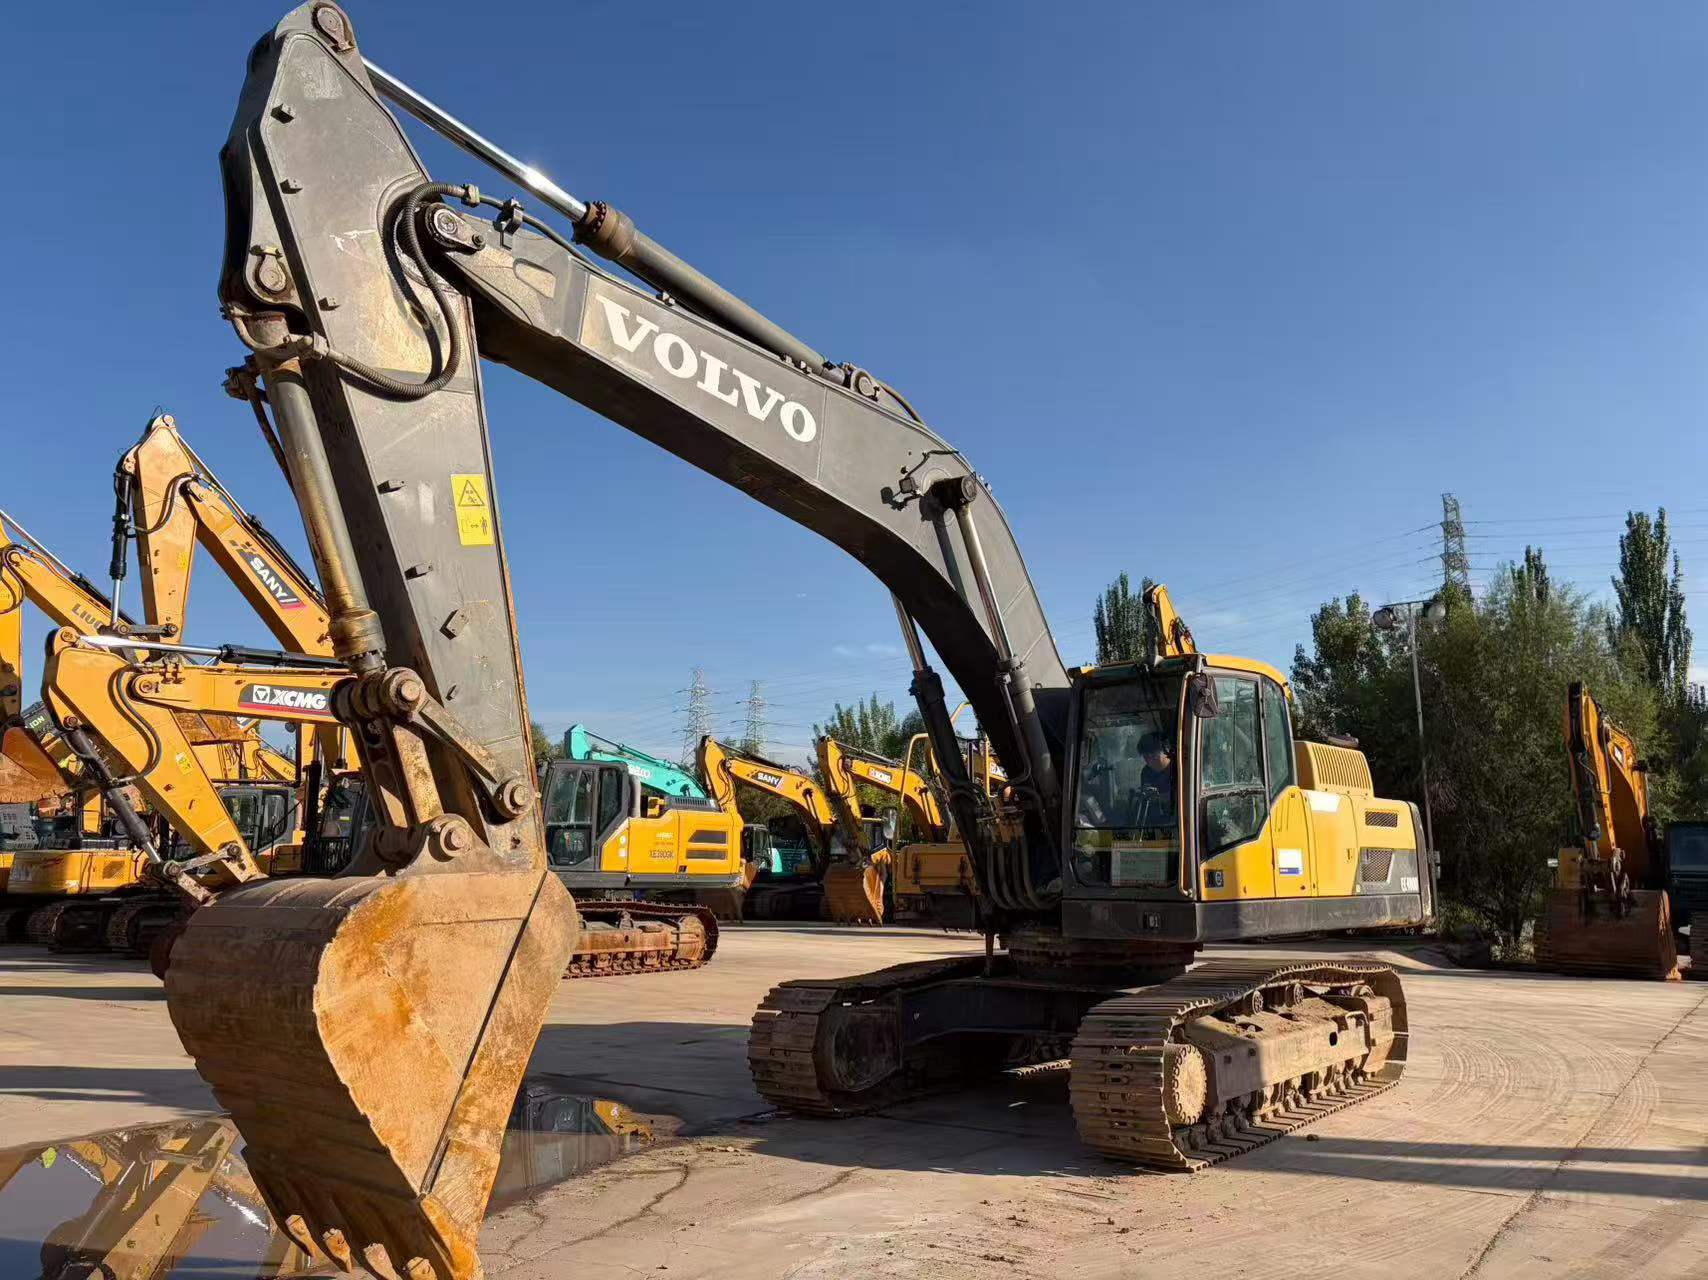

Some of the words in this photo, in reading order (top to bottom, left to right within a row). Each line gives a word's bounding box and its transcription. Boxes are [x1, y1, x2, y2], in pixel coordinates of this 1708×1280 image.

[595, 293, 817, 443] VOLVO
[250, 557, 288, 598] SANY
[270, 688, 327, 710] XCMG
